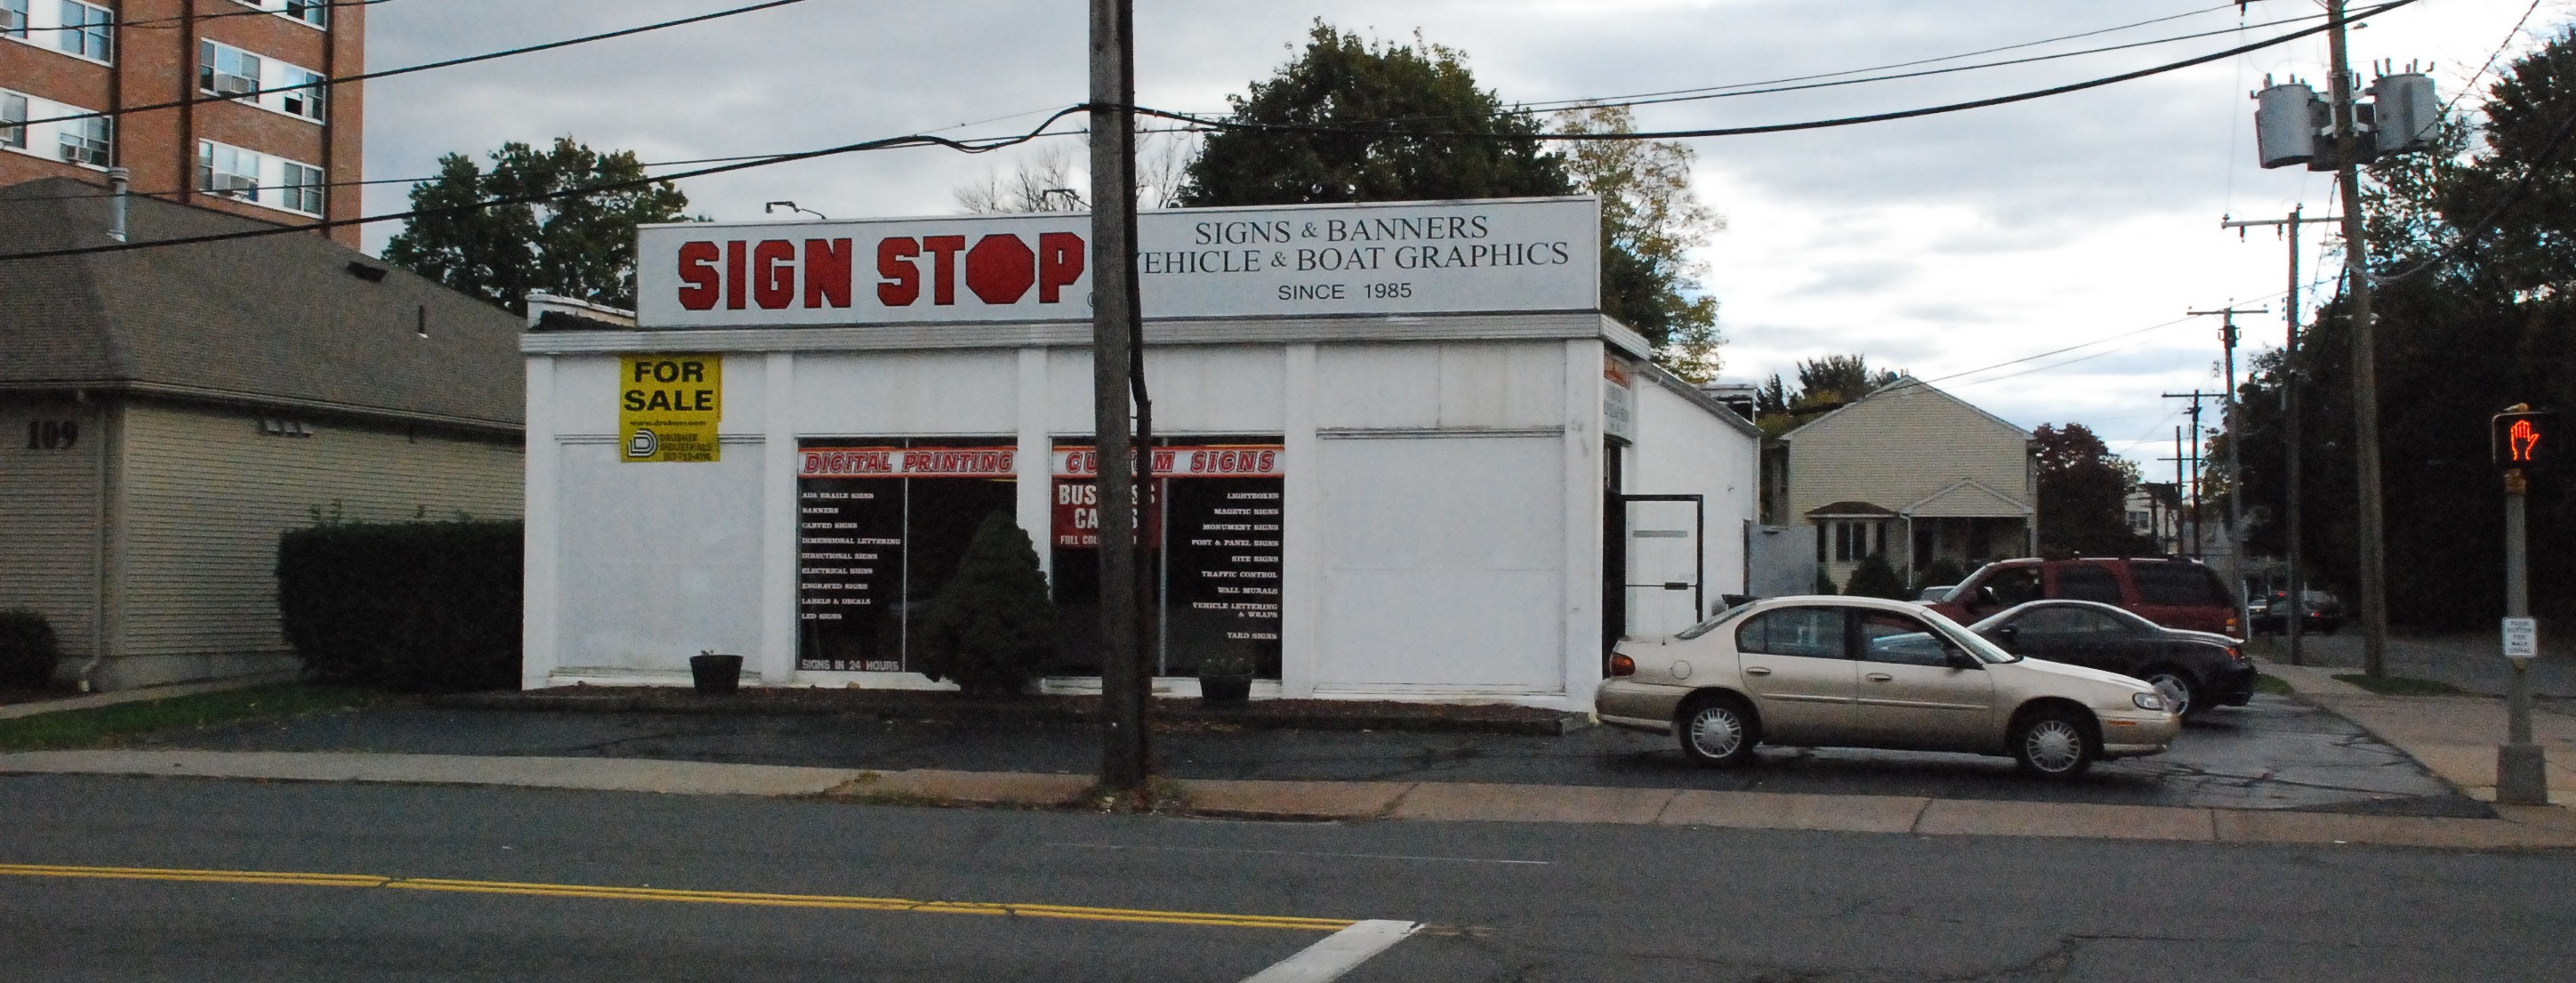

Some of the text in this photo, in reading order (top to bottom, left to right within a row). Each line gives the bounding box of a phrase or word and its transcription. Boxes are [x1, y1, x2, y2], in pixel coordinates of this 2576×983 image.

[1195, 215, 1489, 246] SIGNS & BANNERS
[1136, 240, 1570, 276] EHICLE & BOAT GRAPHICS
[678, 238, 852, 311] SIGN
[1277, 281, 1413, 301] SINCE 1985
[634, 360, 704, 383] FOR
[624, 389, 714, 412] SALE
[28, 419, 78, 451] 109
[803, 451, 1014, 473] DIGITAL PRINTING
[1065, 450, 1276, 473] CUM SIGNS
[801, 491, 818, 499] ADA
[850, 491, 874, 499] SIGNS
[1227, 491, 1279, 501] LIGHTBOXES
[801, 506, 839, 514] BANNERS
[1253, 507, 1279, 516] SIGNS
[801, 521, 857, 529] CARVED SIGNS
[1203, 522, 1279, 531] MONUMENT SIGNS
[801, 536, 901, 545] DIMENSIONAL LETTERING
[1059, 535, 1080, 546] FULL
[1191, 538, 1279, 547] POST & PANEL SIGNS
[801, 552, 878, 560] DIRECTIONAL SIGNS
[1231, 554, 1279, 563] SITE SIGNS
[801, 567, 873, 575] ELECTRICAL SIGNS
[1201, 569, 1278, 578] TRAFFIC CONTROL
[801, 582, 868, 590] ENGRAVED SIGNS
[1217, 585, 1278, 595] WALL MURALS
[801, 597, 871, 605] LABELS & DECALS
[1192, 600, 1278, 610] VEHICLE LETTERING
[801, 612, 842, 620] LED SIGNS
[1238, 610, 1278, 618] & WRAPS
[1227, 631, 1277, 640] YARD SIGNS
[801, 659, 899, 672] SIGNS IN 24 HOURS
